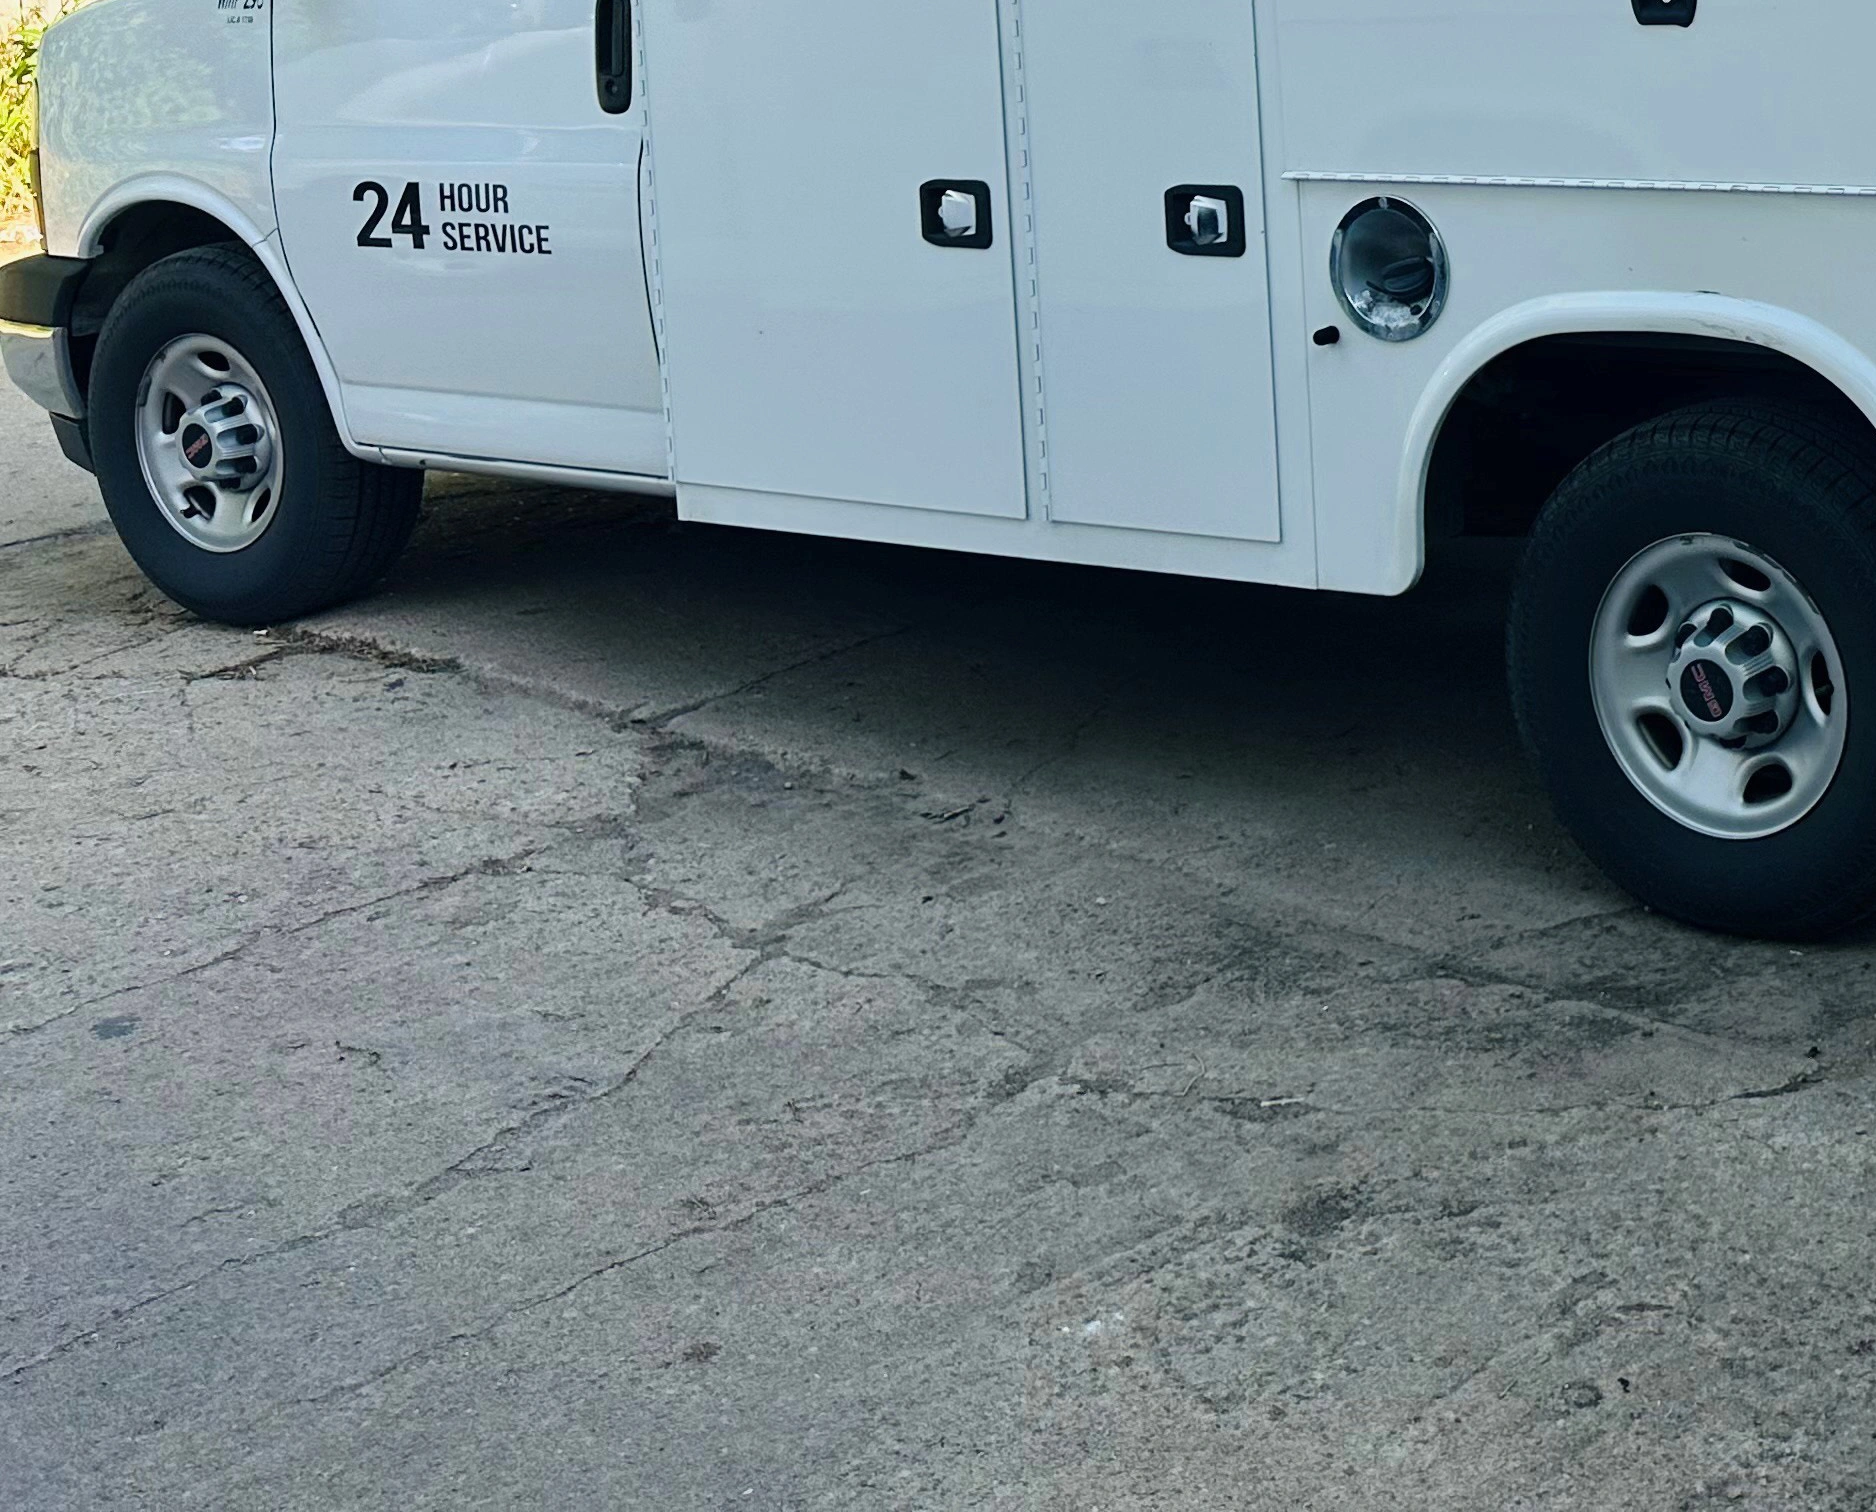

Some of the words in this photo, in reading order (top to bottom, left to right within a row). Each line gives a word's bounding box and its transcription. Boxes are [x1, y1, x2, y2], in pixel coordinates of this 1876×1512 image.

[352, 180, 431, 250] 24
[438, 182, 510, 214] HOUR
[441, 221, 552, 255] SERVICE
[1690, 663, 1723, 719] GMC
